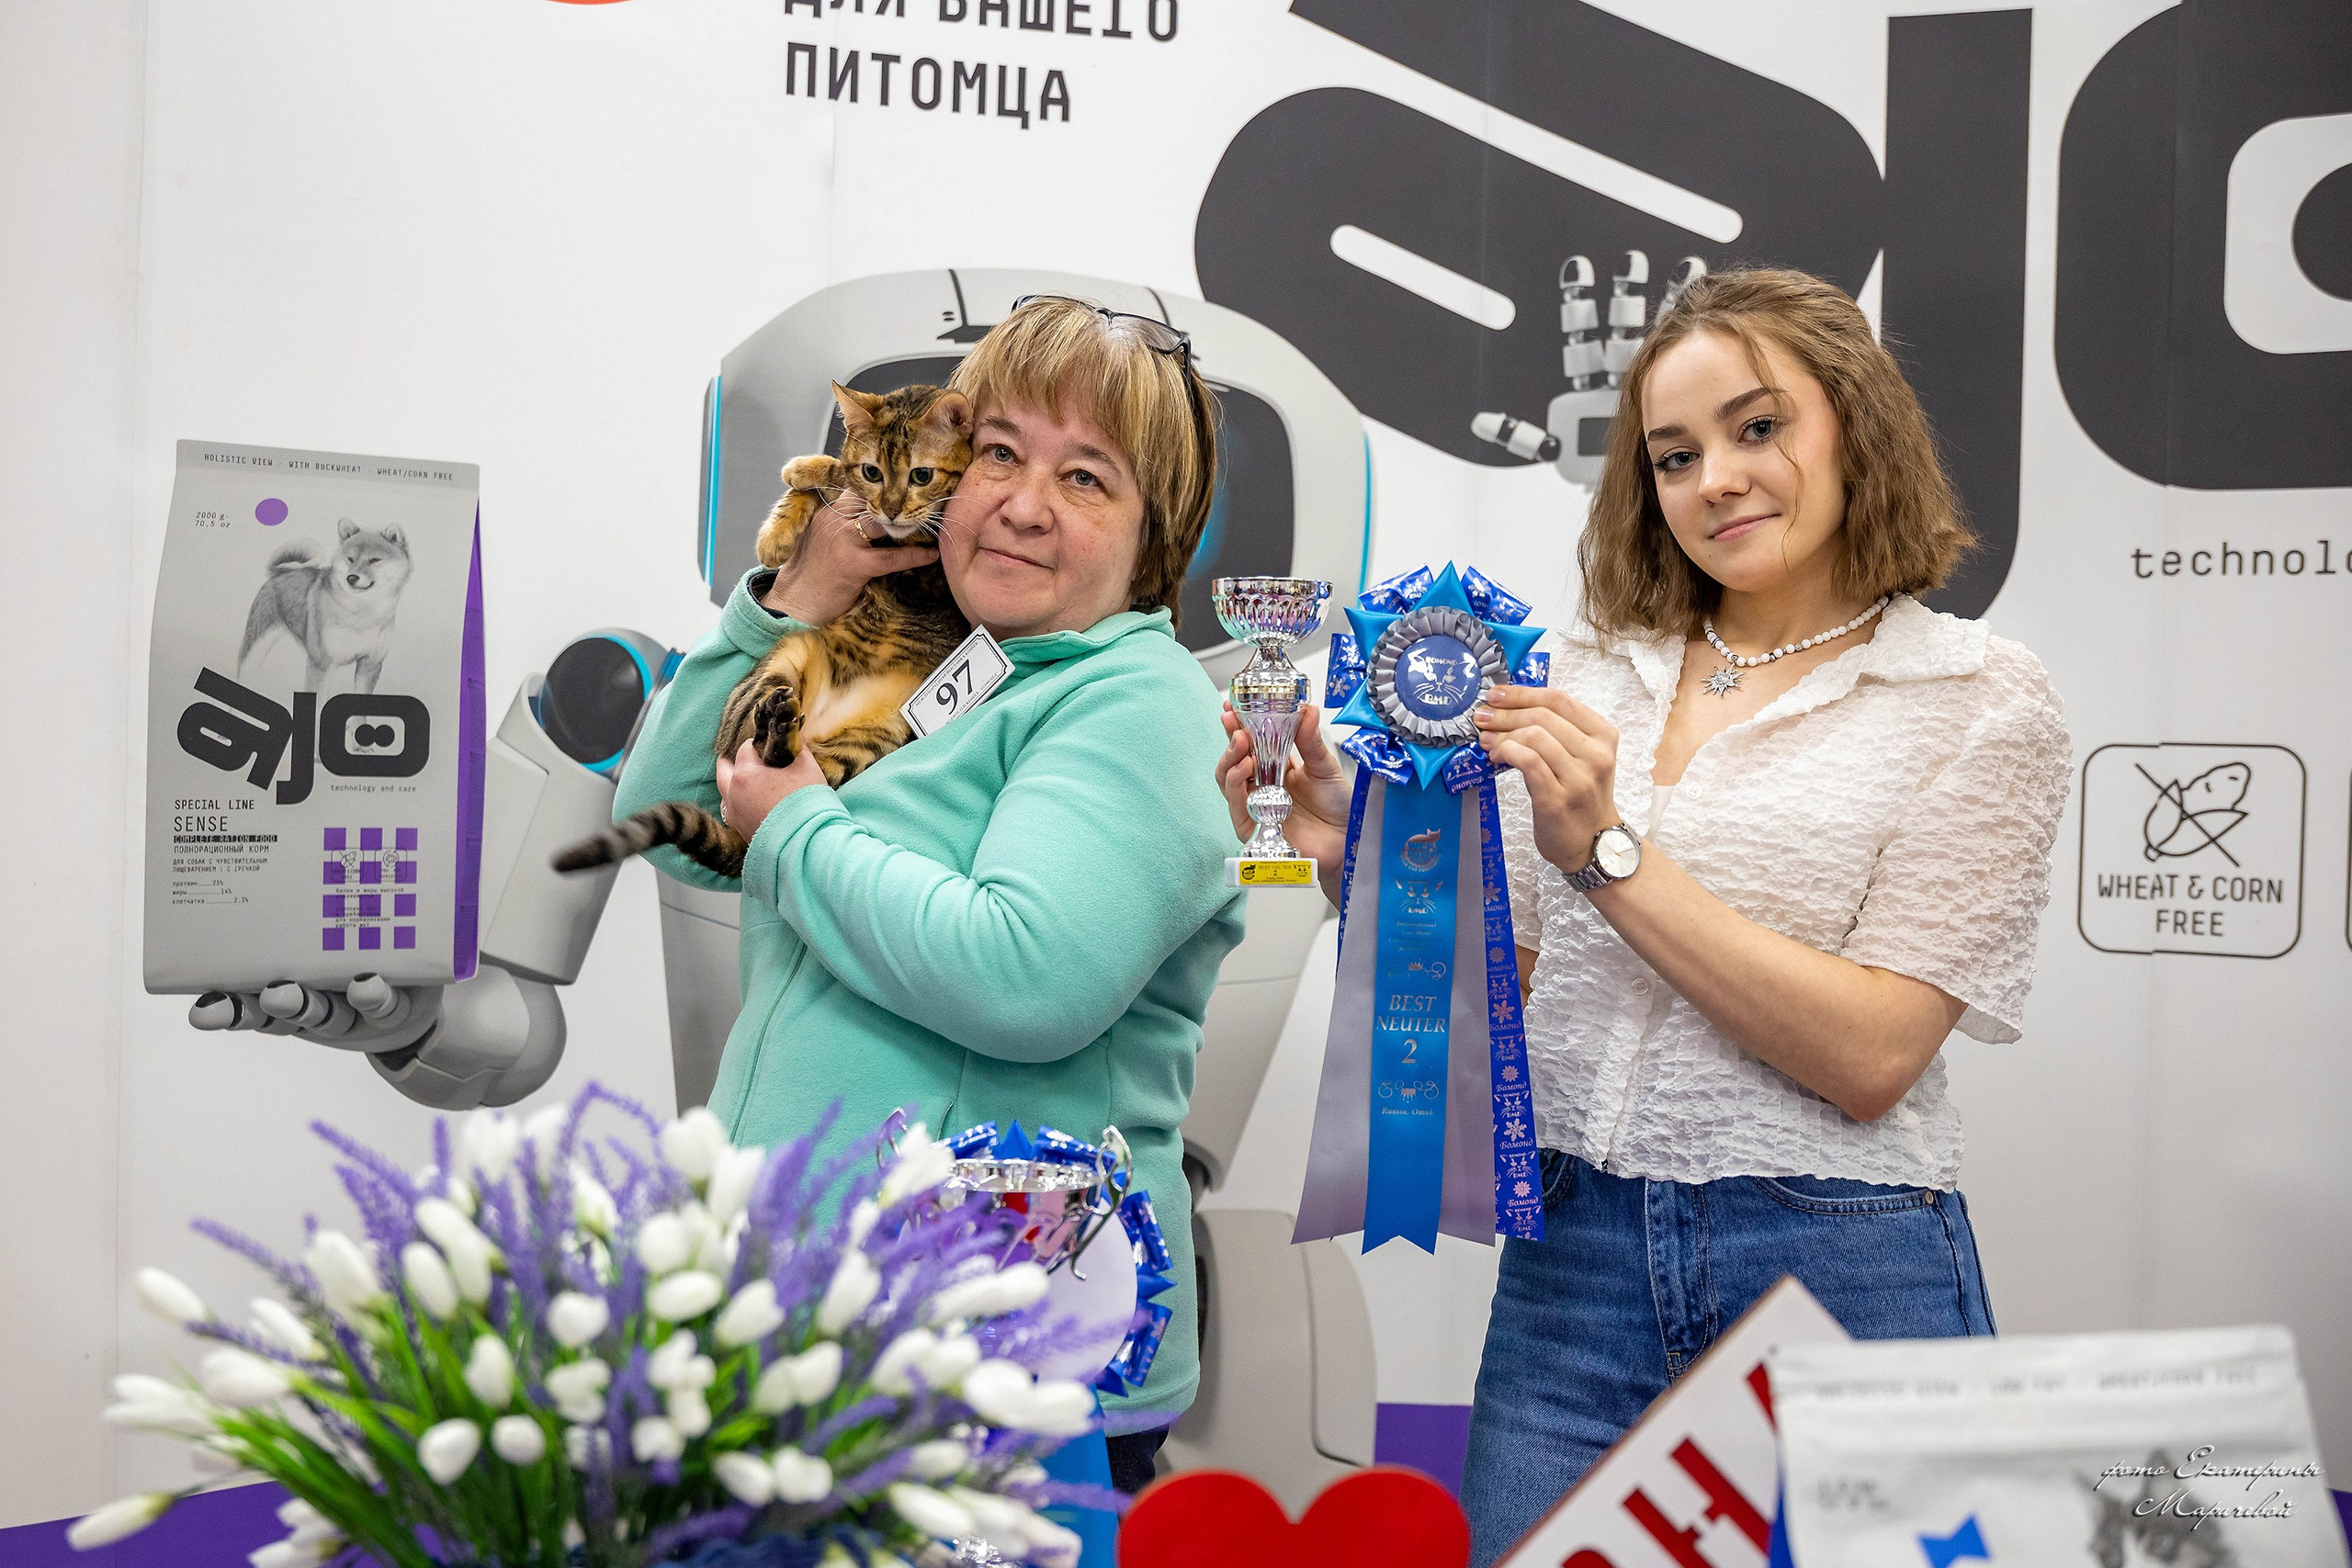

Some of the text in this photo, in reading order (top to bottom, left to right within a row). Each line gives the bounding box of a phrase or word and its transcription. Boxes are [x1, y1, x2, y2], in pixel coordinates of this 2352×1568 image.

[786, 41, 1070, 130] ПИТОМЦА
[204, 454, 246, 464] HOLISTIC
[252, 457, 273, 466] VIEW
[315, 463, 361, 473] BUCKWHEAT
[377, 468, 428, 478] WHEAT/CORN
[434, 472, 453, 480] FREE
[2131, 539, 2352, 579] technol
[936, 659, 973, 715] 97
[331, 784, 376, 793] technology
[175, 799, 254, 809] SPECIAL LINE
[174, 816, 228, 832] SENSE
[175, 835, 215, 843] COMPLETE
[255, 834, 276, 842] FOOD
[174, 844, 269, 854] ПОЛНОРАЦИОННЫЙ КОРМ
[2098, 873, 2283, 904] WHEAT & CORN
[2156, 909, 2223, 937] FREE
[1389, 994, 1437, 1012] BEST
[1376, 1016, 1446, 1032] NEUTER
[1401, 1038, 1417, 1064] 2
[1496, 1080, 1527, 1092] Бомонд
[1382, 1107, 1408, 1115] Russia,
[1499, 1137, 1533, 1150] Бомонд
[1507, 1195, 1539, 1207] Бомонд
